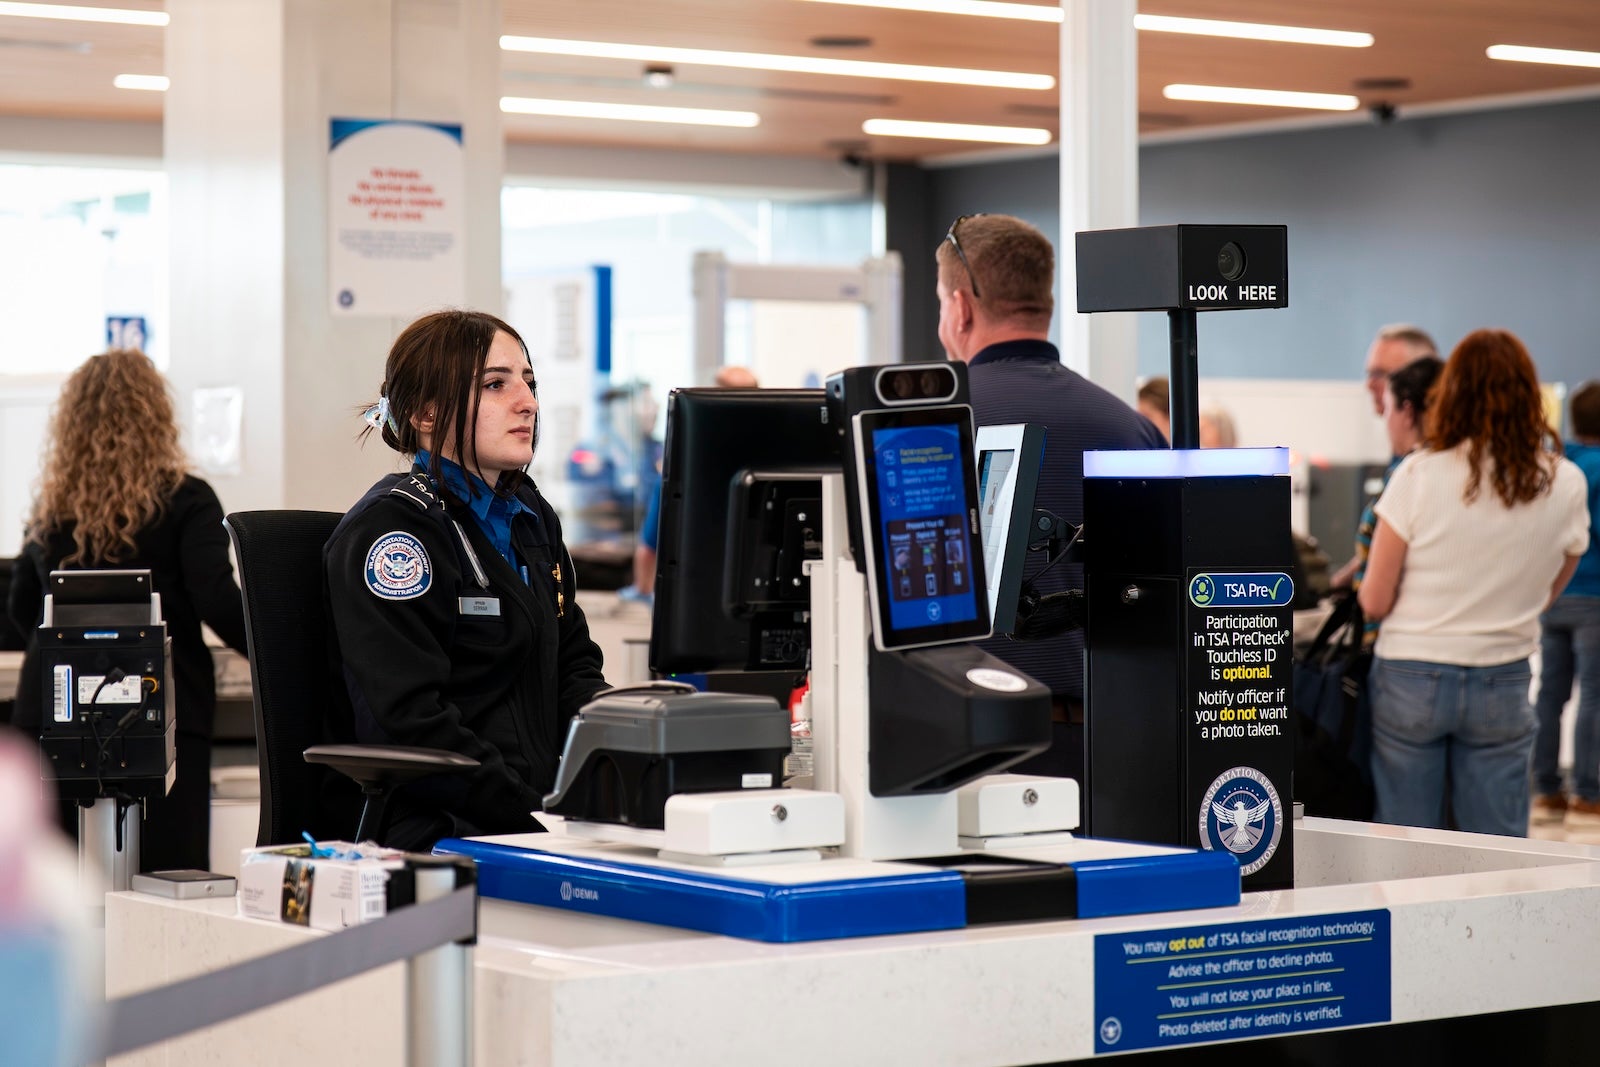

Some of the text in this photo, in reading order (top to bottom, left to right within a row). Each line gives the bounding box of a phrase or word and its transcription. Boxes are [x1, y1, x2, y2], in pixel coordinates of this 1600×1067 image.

[1189, 285, 1277, 301] LOOK HERE
[368, 536, 430, 575] TRANSPORTATION SECURITY
[372, 581, 424, 596] ADMINISTRATION
[1224, 583, 1247, 598] TSA
[1206, 614, 1278, 631] Participation
[1194, 632, 1205, 646] in
[1207, 632, 1230, 647] TSA
[1207, 648, 1277, 664] Touchless ID
[1211, 664, 1273, 682] is optional.
[1198, 688, 1286, 707] Notify officer if
[1195, 705, 1288, 725] you do not want
[1201, 722, 1282, 741] a photo taken.
[1200, 768, 1283, 831] TRANSPORTATION SECURITY
[572, 887, 599, 901] IDEMIA
[1122, 920, 1376, 955] You may opt out of TSA facial recognition technology.
[1168, 951, 1334, 978] Advise the officer to decline photo.
[1169, 979, 1333, 1008] You will not lose your place in line.
[1159, 1004, 1343, 1038] Photo deleted after identity is verified.
